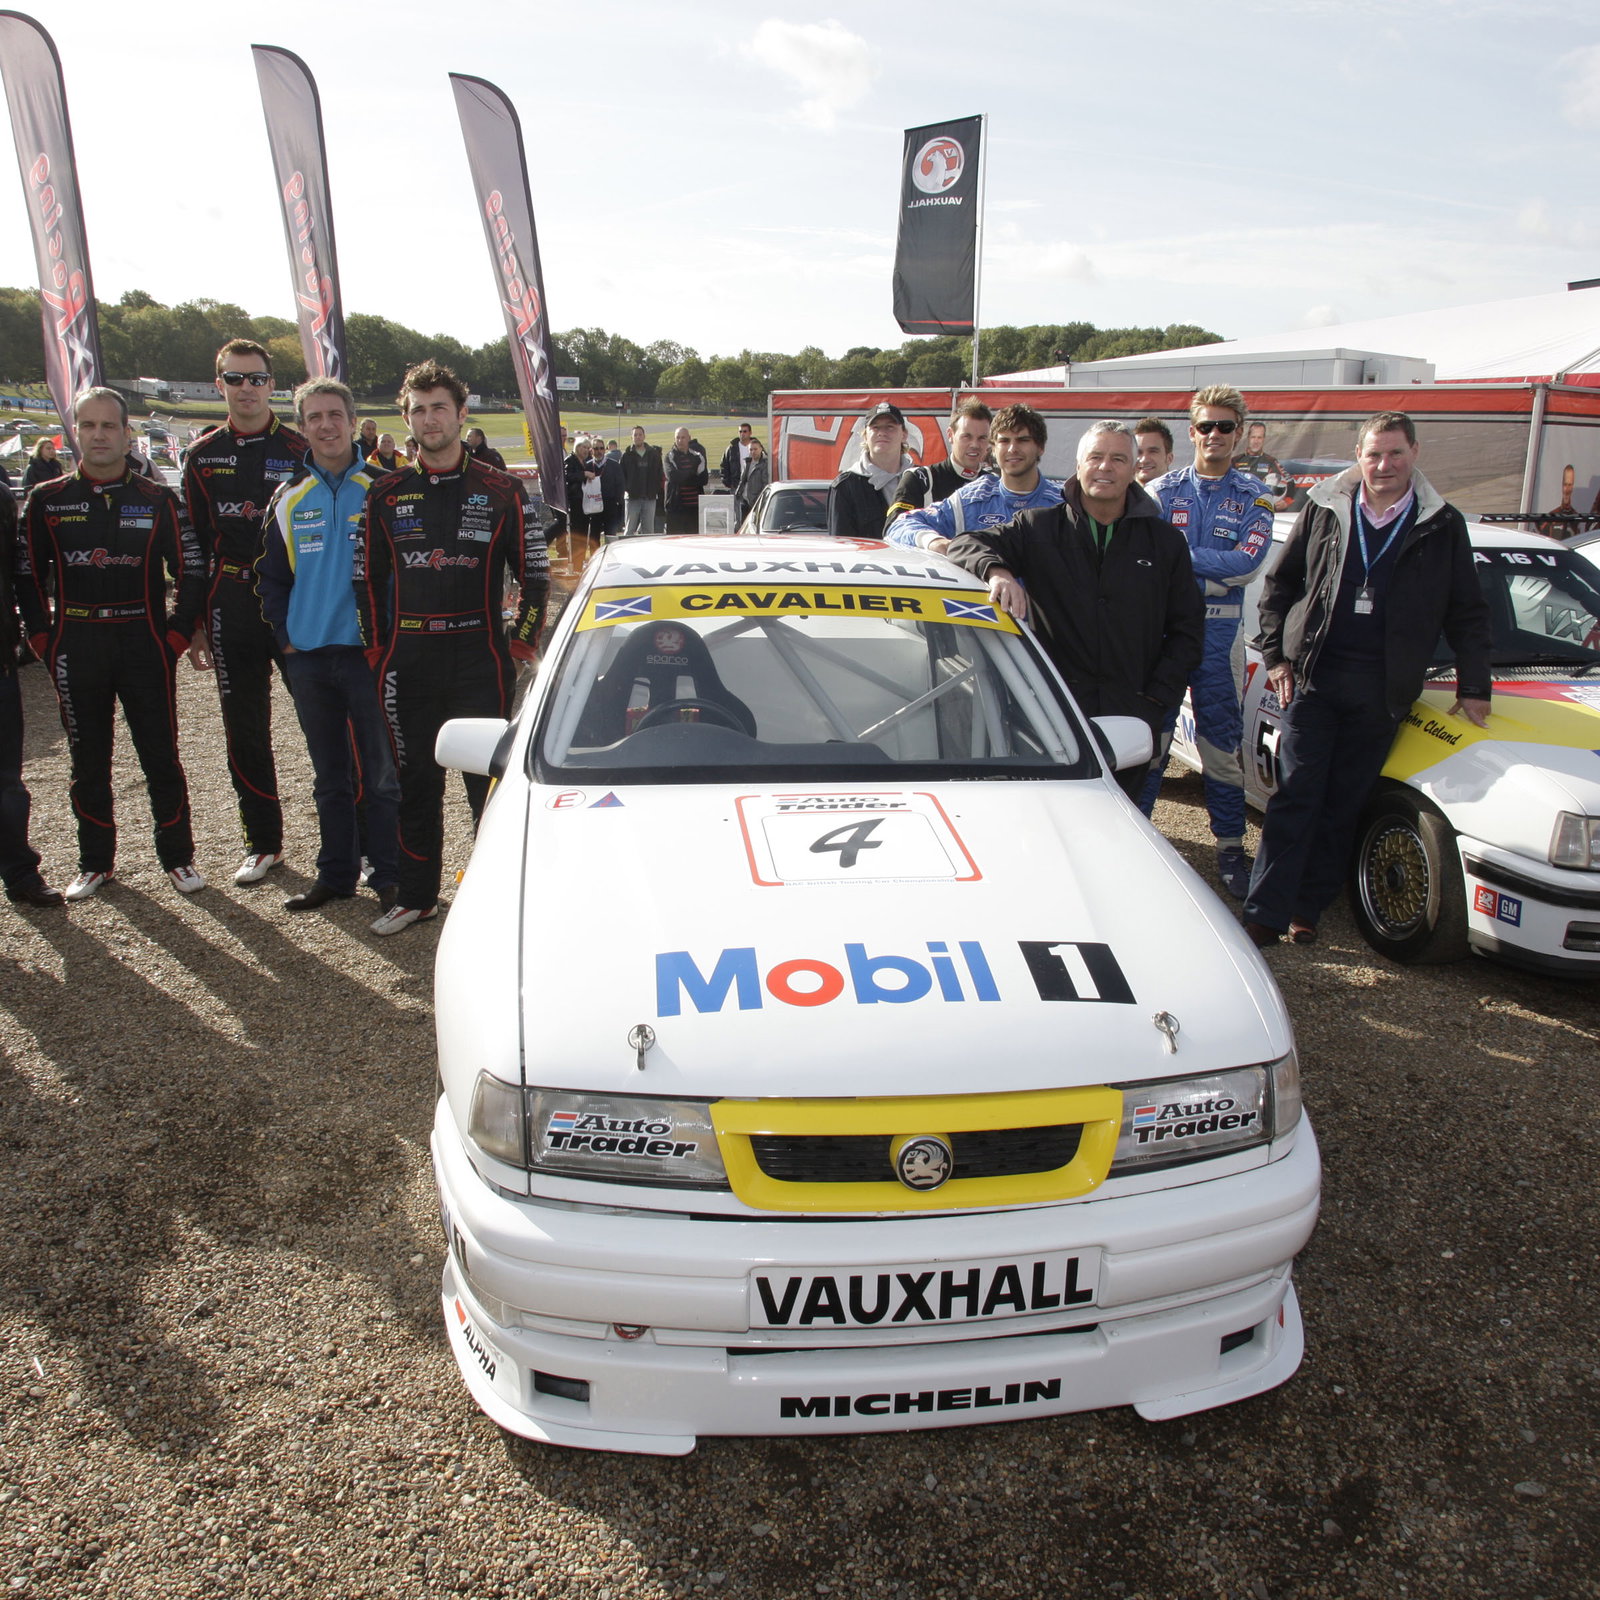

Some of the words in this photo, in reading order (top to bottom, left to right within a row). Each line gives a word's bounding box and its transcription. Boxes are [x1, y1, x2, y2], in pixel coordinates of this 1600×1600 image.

[266, 459, 295, 467] GMAC
[397, 494, 424, 502] PIRTEK
[121, 505, 153, 513] GMAC
[304, 511, 314, 519] 99
[396, 505, 414, 514] CBT
[393, 519, 423, 529] GMAC
[983, 516, 1000, 524] Ford
[459, 530, 475, 538] HiQ
[1501, 552, 1533, 565] 16
[1537, 554, 1557, 567] V
[636, 561, 958, 582] VAUXHALL
[680, 593, 923, 614] CAVALIER
[211, 608, 231, 696] VAUXHALL
[385, 671, 408, 769] VAUXHALL
[1423, 720, 1463, 746] Cleland
[1257, 721, 1274, 788] 5
[553, 792, 578, 808] E
[776, 803, 907, 811] Trader
[809, 818, 886, 869] 4
[1501, 899, 1518, 916] GM
[655, 941, 1001, 1017] Mobil
[1048, 944, 1101, 999] 1
[1156, 1097, 1235, 1121] Auto
[576, 1112, 671, 1136] Auto
[1133, 1111, 1257, 1144] Trader
[547, 1131, 698, 1158] Trader
[755, 1257, 1094, 1328] VAUXHALL
[463, 1324, 497, 1382] ALPHA
[781, 1379, 1062, 1415] MICHELIN
